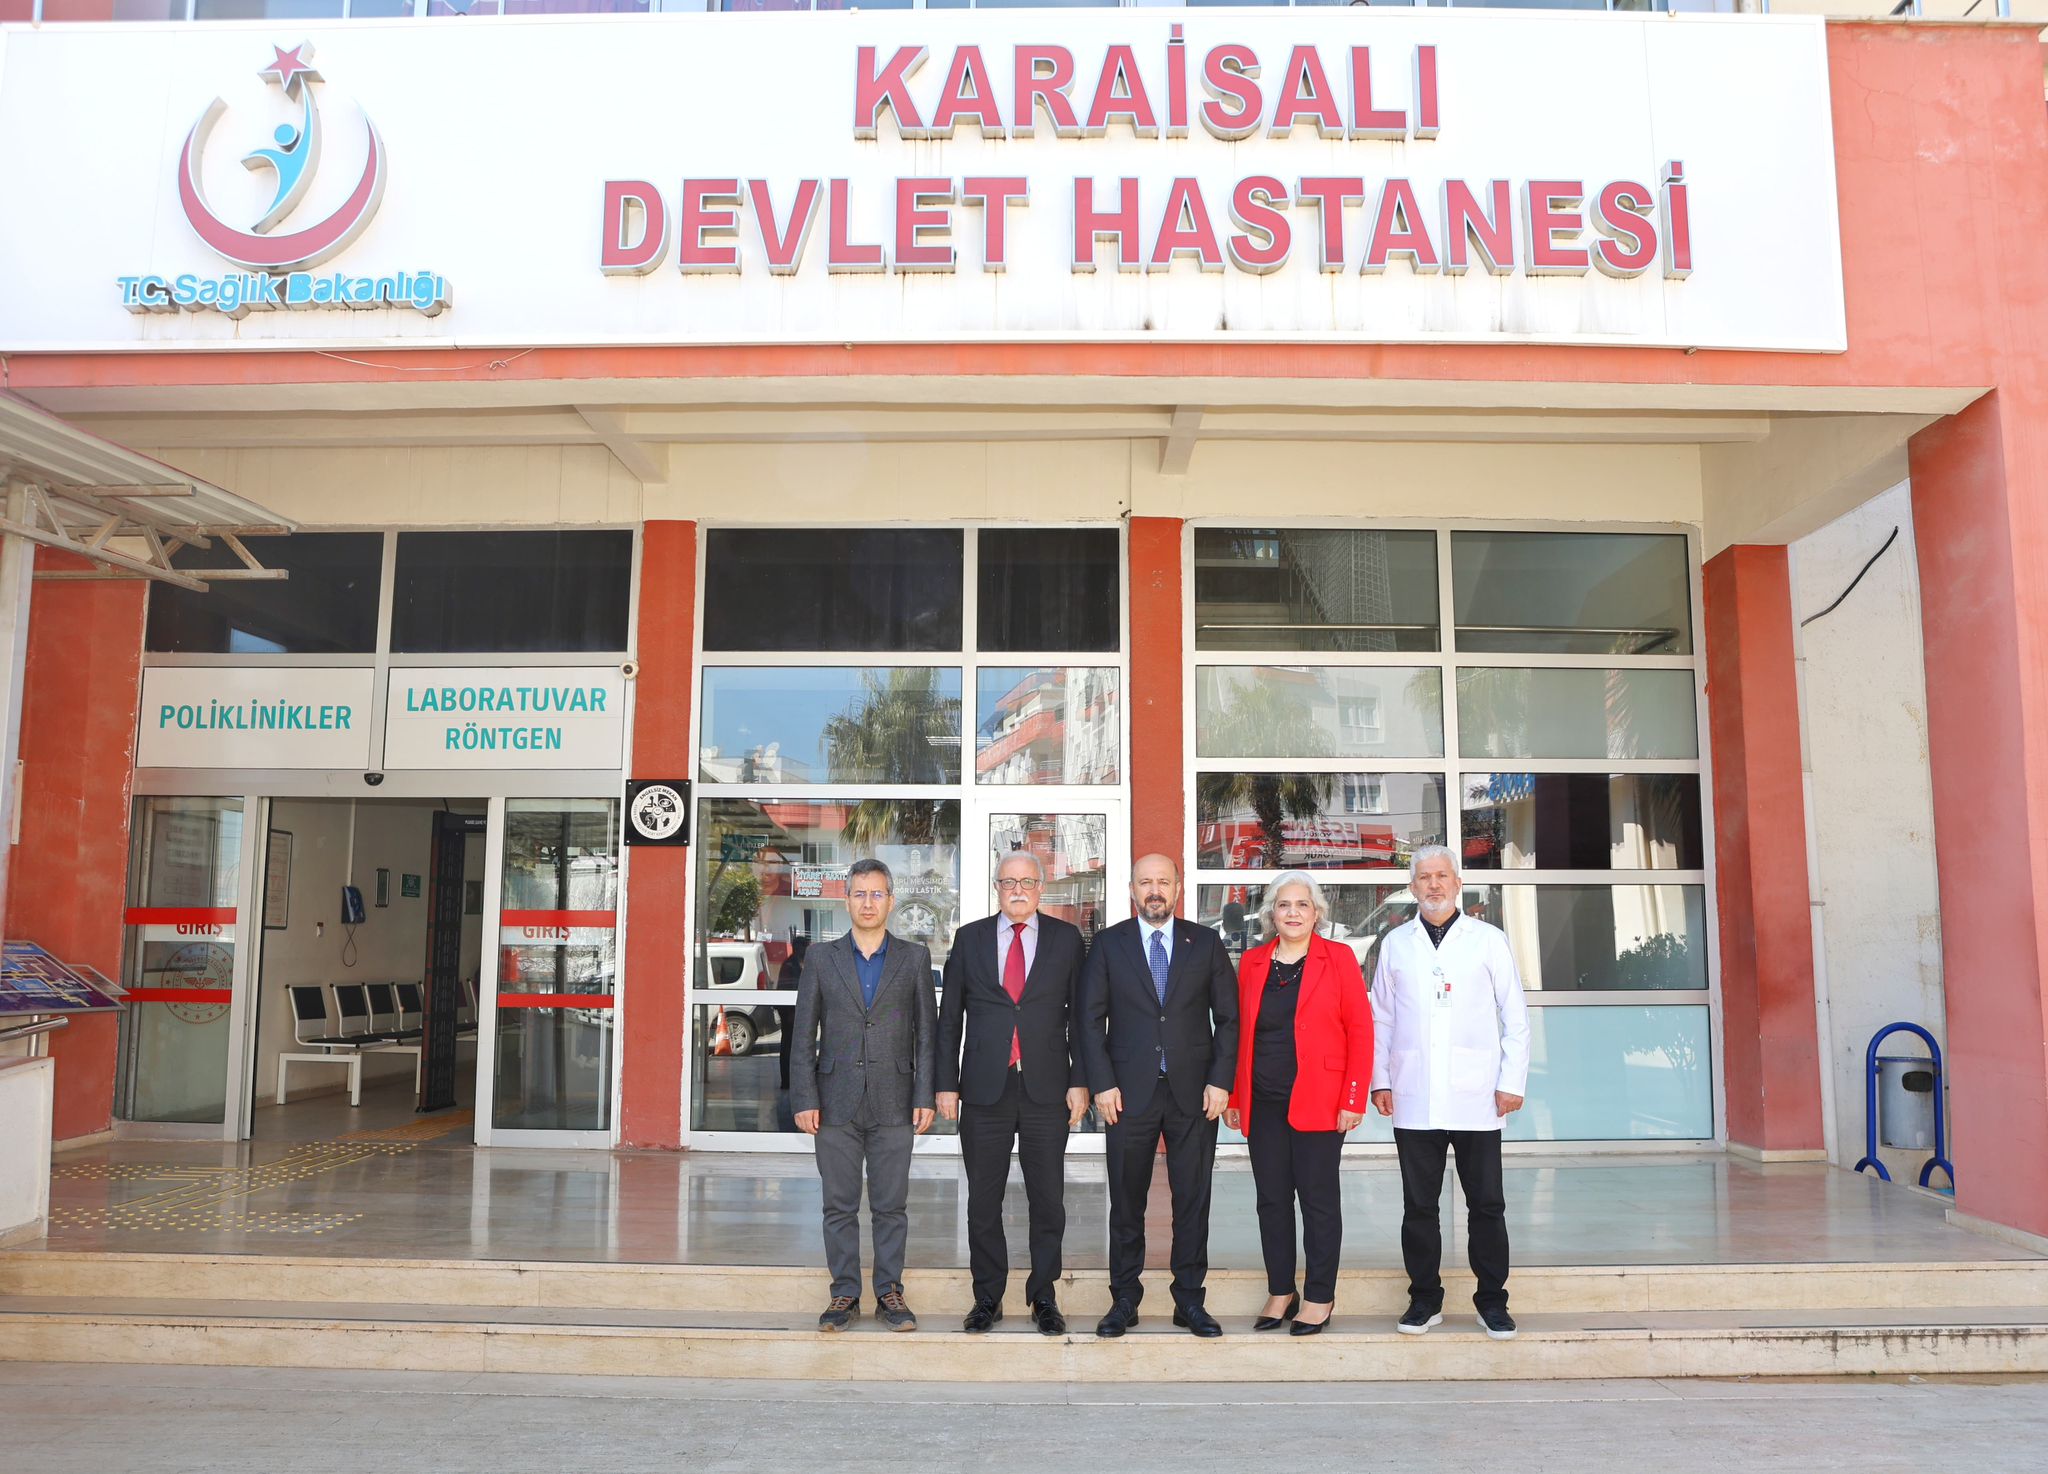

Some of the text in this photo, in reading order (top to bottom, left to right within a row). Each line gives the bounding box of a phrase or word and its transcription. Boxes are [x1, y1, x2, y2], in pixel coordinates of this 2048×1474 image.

[853, 24, 1440, 136] KARAİSALI
[600, 160, 1693, 277] DEVLET HASTANESİ
[115, 271, 449, 313] T.C. Sağlık Bakanlığı
[160, 698, 352, 730] POLİKLİNİKLER
[406, 686, 608, 713] LABORATUVAR
[445, 721, 563, 750] RÖNTGEN
